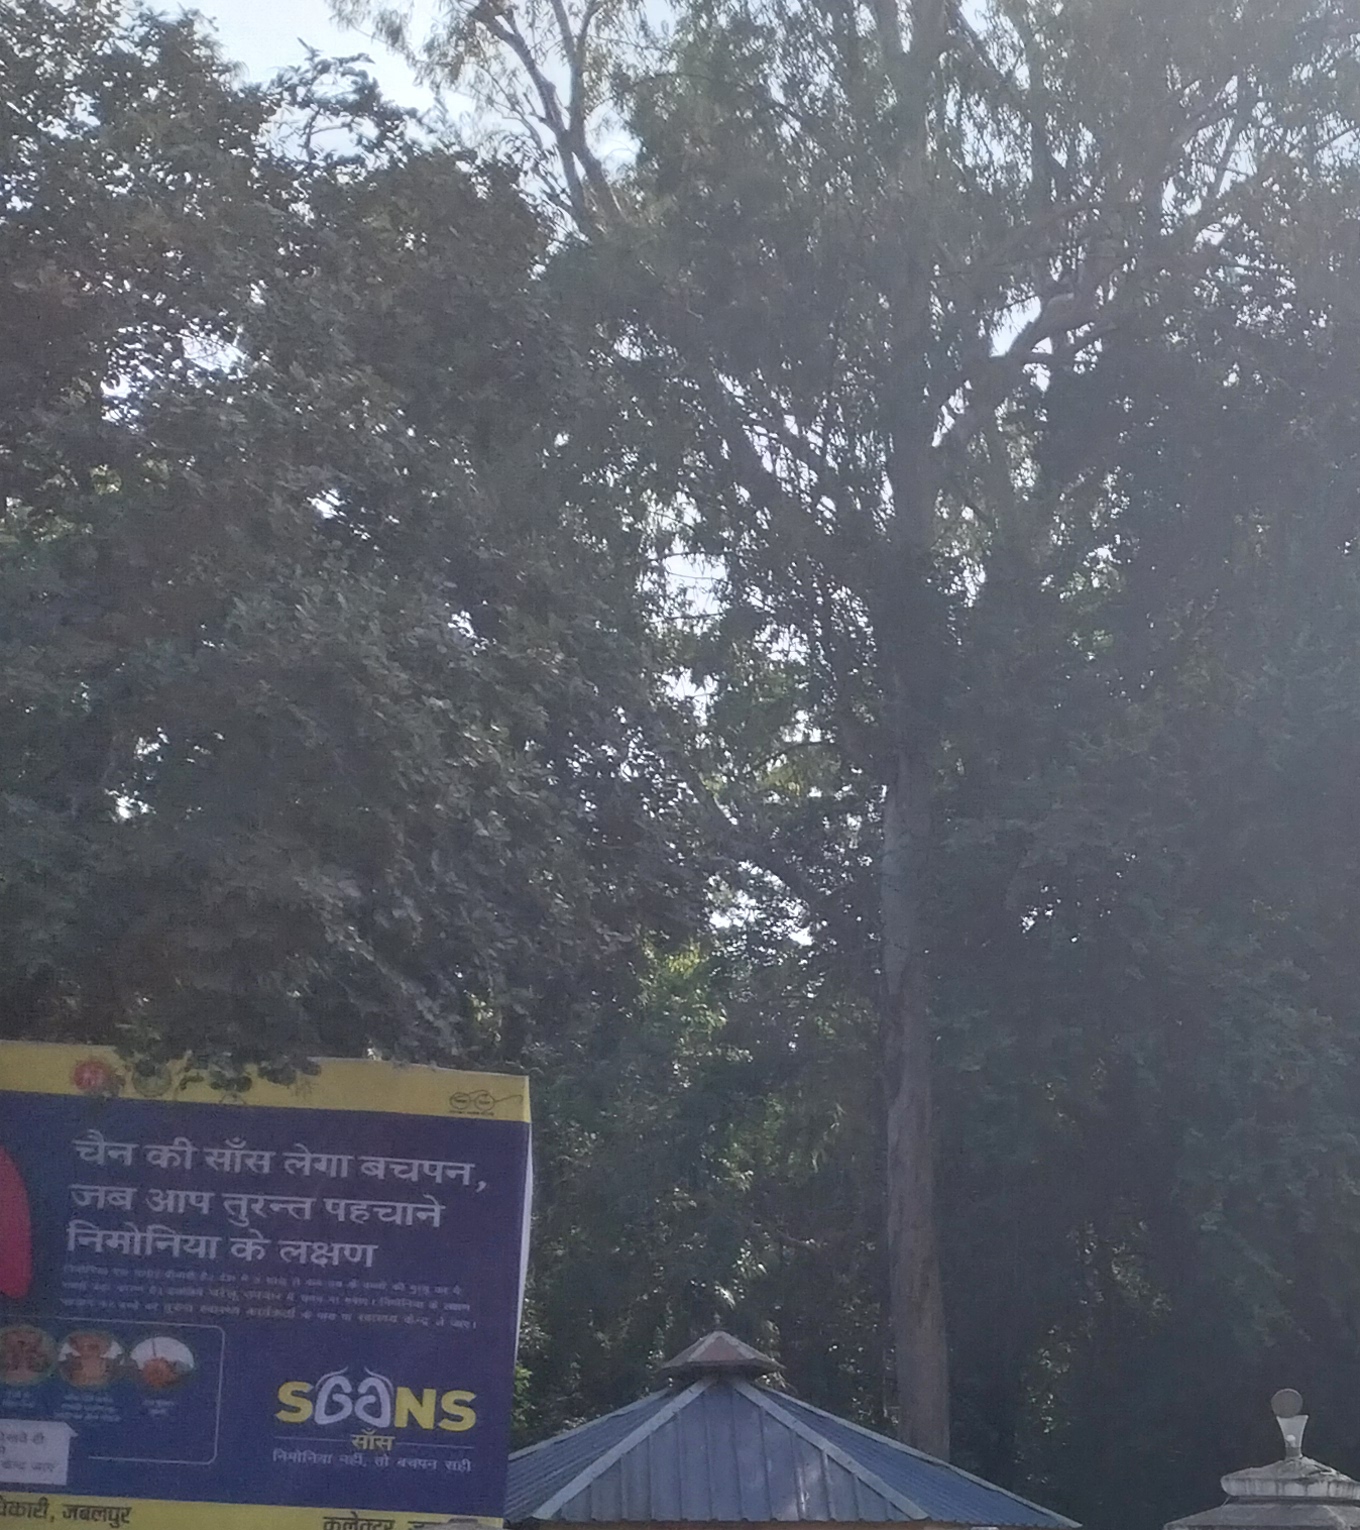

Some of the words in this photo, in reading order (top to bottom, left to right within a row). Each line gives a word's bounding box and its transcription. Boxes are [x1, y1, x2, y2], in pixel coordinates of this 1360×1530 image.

[72, 1129, 139, 1166] चैन
[143, 1137, 198, 1169] की
[203, 1137, 276, 1174] साँस
[283, 1143, 354, 1177] लेगा
[358, 1156, 487, 1192] बचपन,
[68, 1184, 138, 1210] जब
[145, 1188, 215, 1214] आप
[222, 1193, 317, 1227] तुरन्त
[323, 1194, 446, 1228] पहचाने
[66, 1219, 223, 1259] निमोनिया
[230, 1228, 271, 1261] के
[277, 1240, 379, 1268] लक्षण
[62, 1504, 132, 1528] जबलपुर
